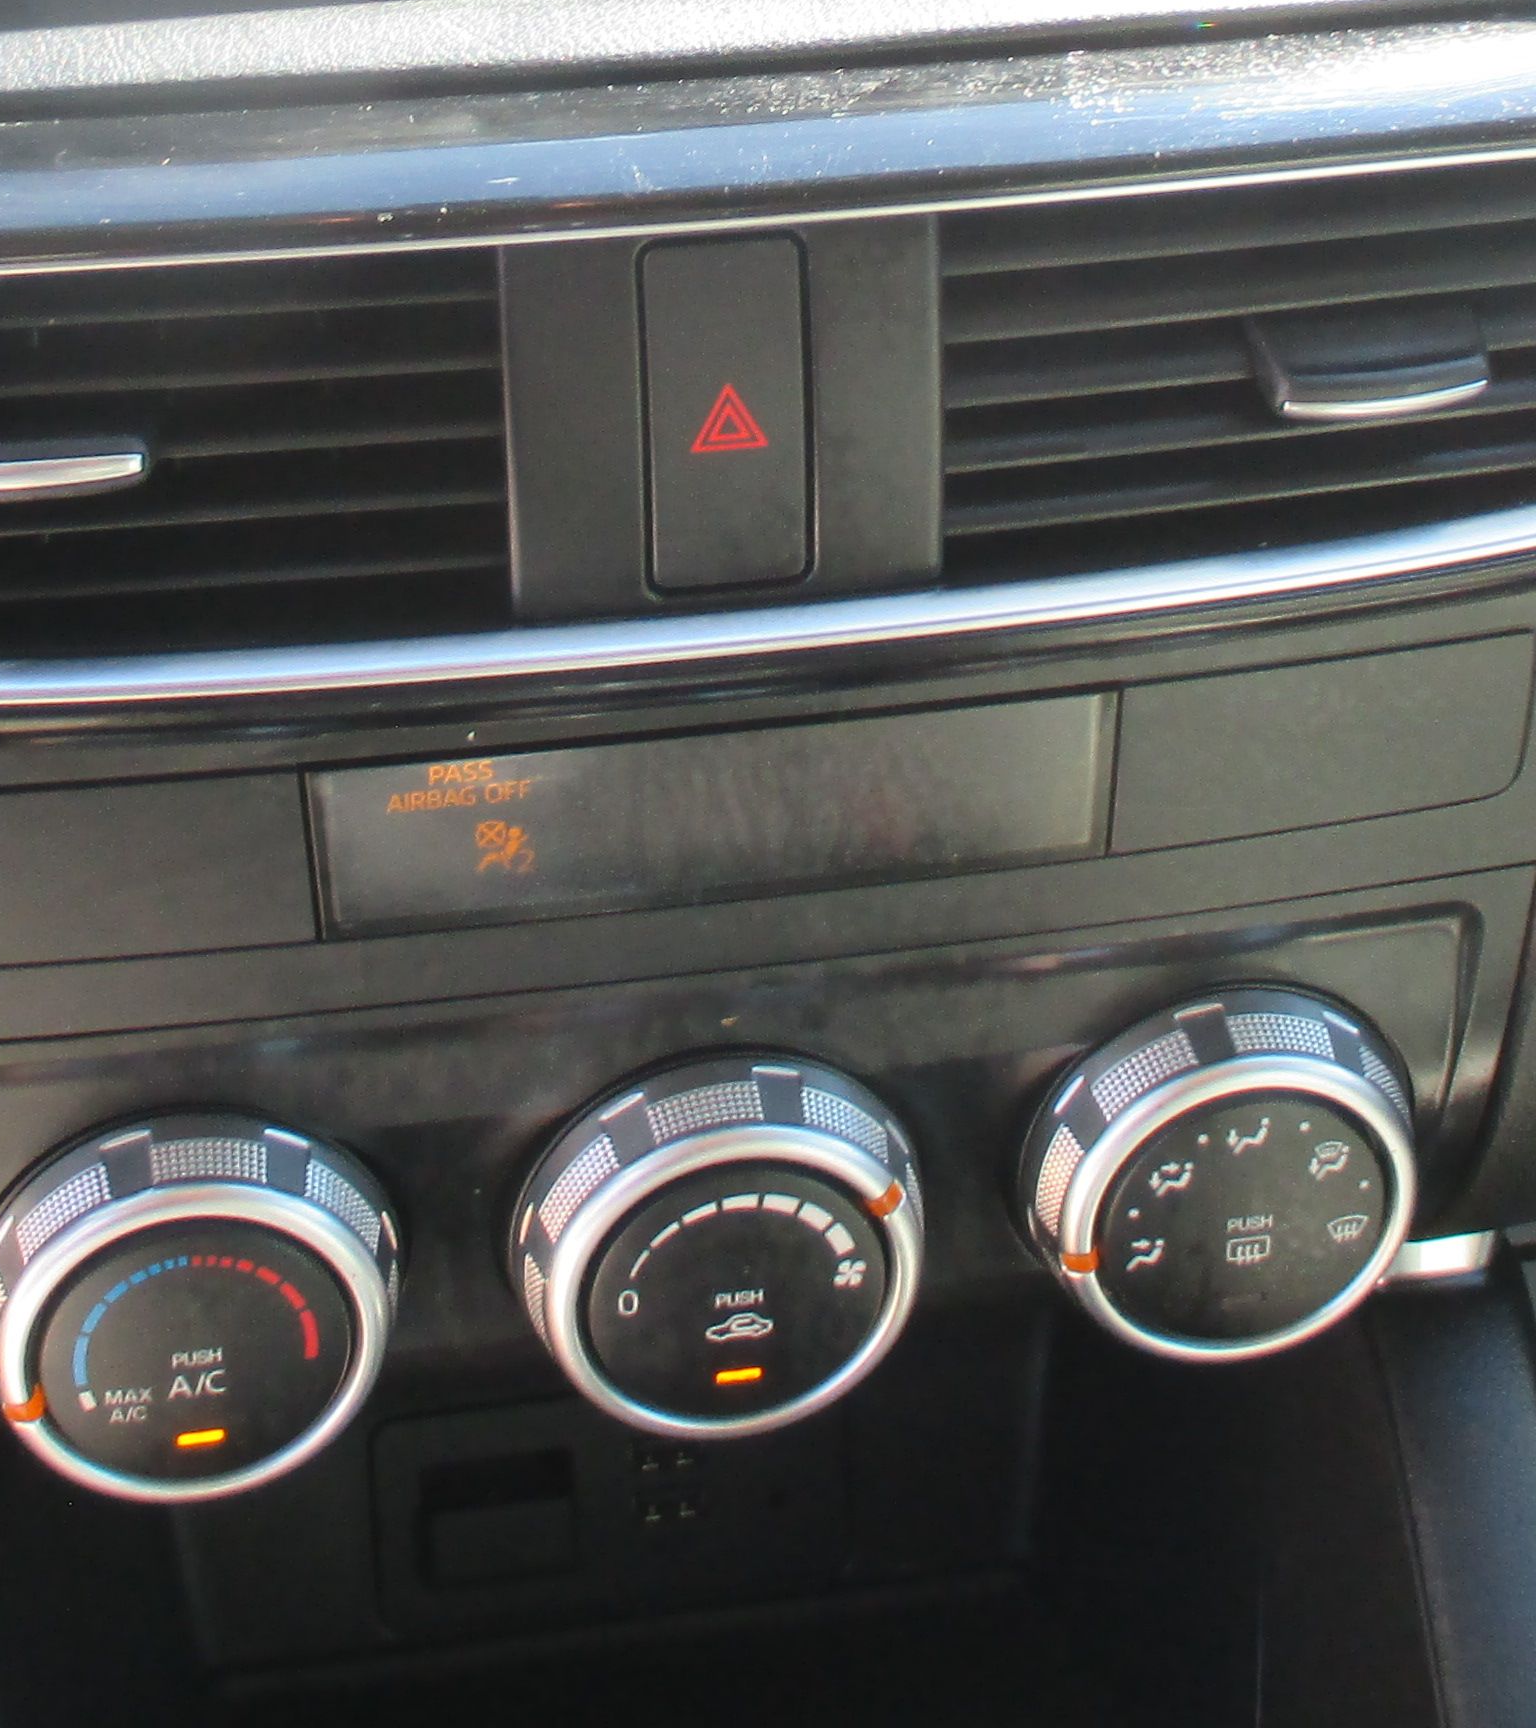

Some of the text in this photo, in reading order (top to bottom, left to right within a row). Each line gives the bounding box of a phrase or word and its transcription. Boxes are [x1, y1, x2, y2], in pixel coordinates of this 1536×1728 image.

[428, 759, 495, 785] PASS
[386, 779, 532, 815] AIRBAG OFF
[1227, 1214, 1273, 1234] PUSH
[617, 1289, 640, 1318] 0
[715, 1288, 764, 1309] PUSH
[171, 1347, 224, 1369] PUSH
[167, 1368, 227, 1401] A/C
[104, 1386, 154, 1407] MAX
[109, 1405, 148, 1424] A/C
